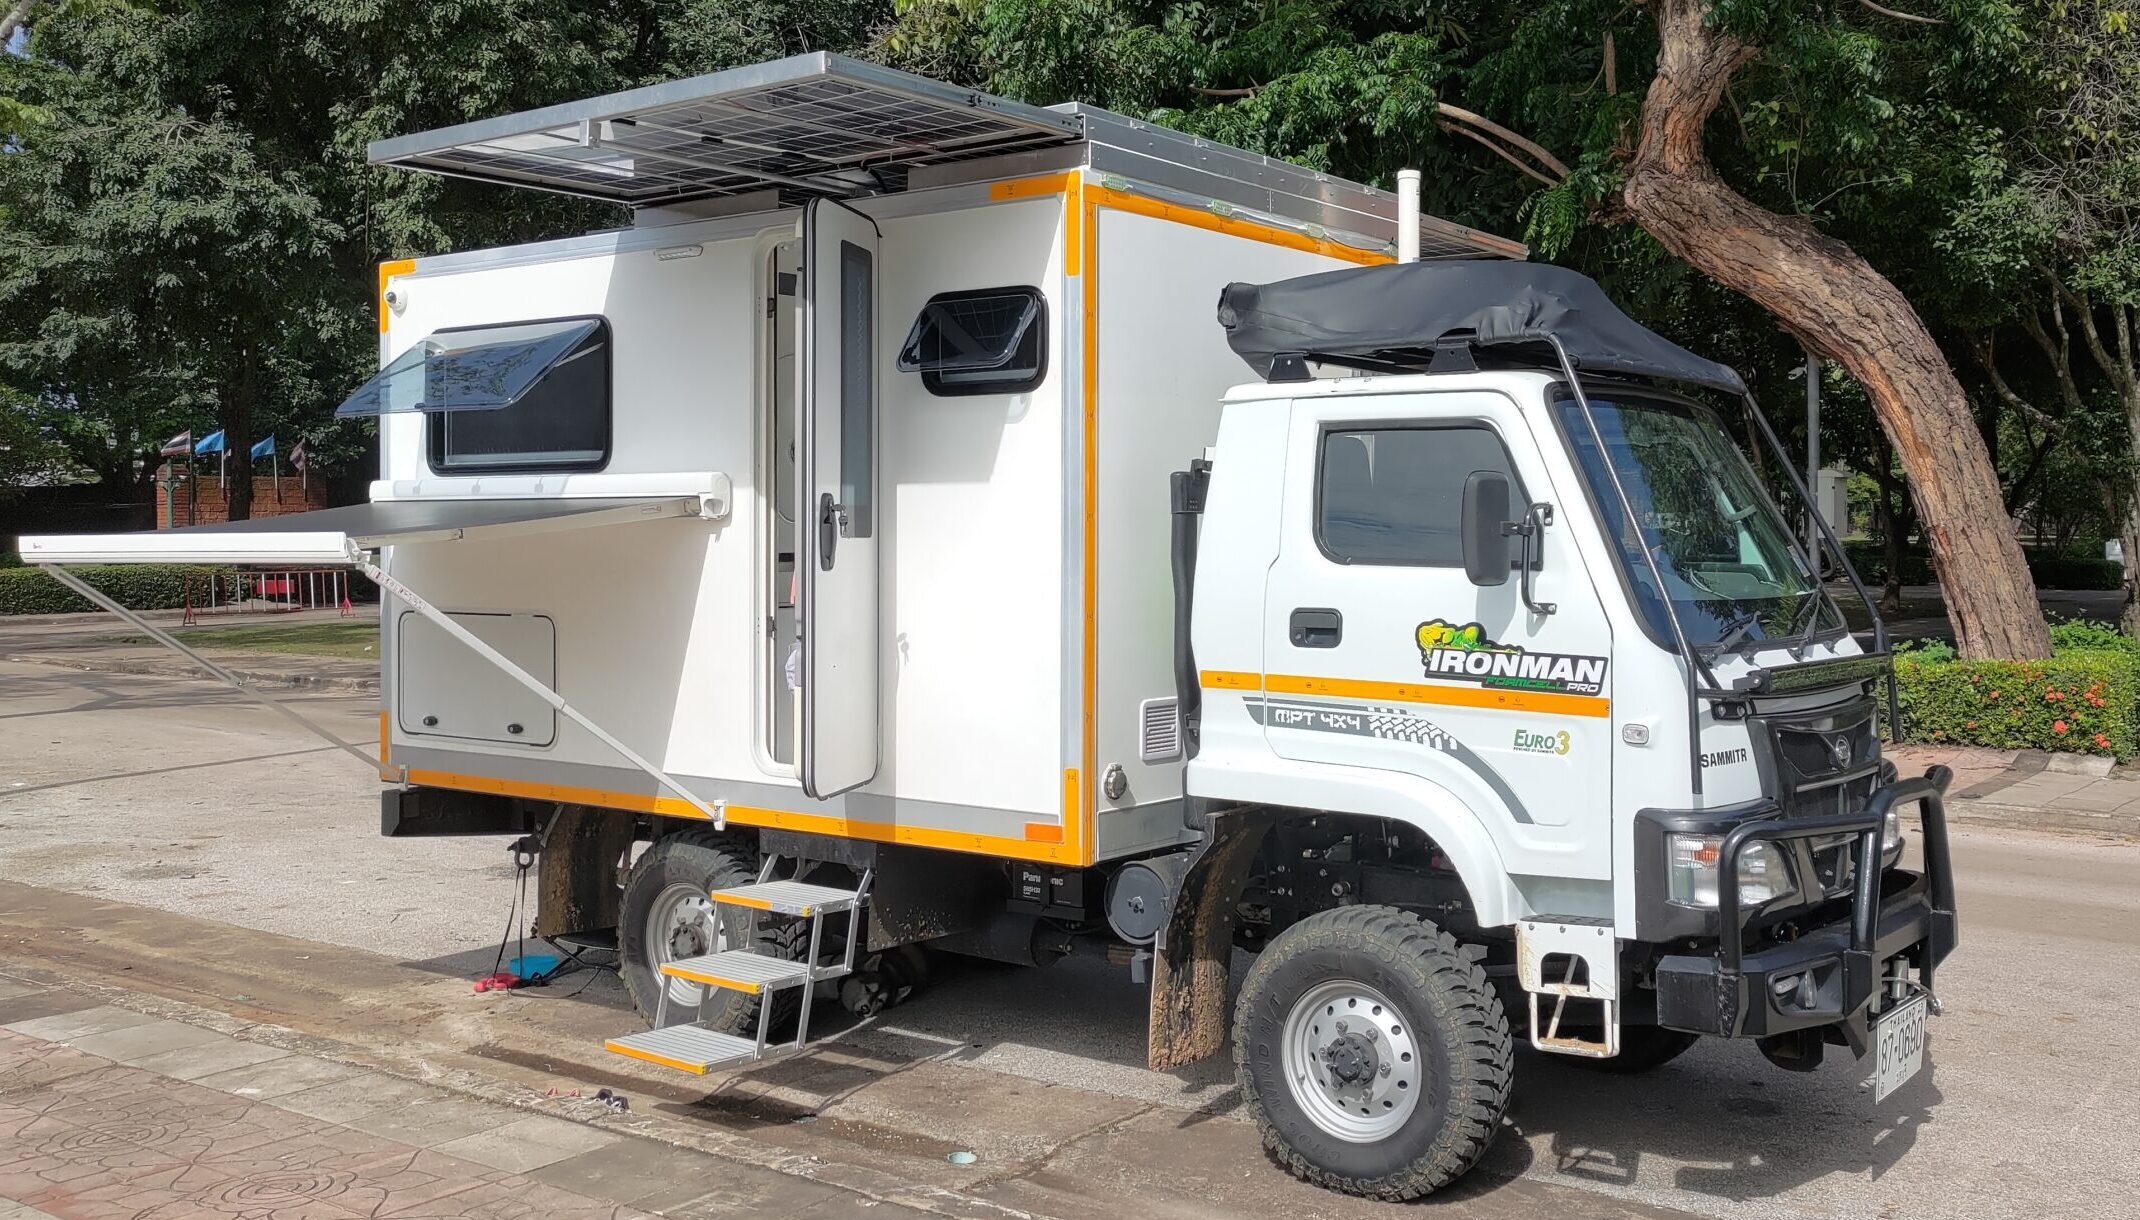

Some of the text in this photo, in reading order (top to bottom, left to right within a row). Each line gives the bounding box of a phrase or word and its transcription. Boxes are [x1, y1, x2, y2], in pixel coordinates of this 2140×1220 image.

[1429, 650, 1604, 683] IRONMAN
[1566, 682, 1599, 693] PRO
[1275, 709, 1316, 726] MPT
[1700, 748, 1747, 768] SAMMITR
[1881, 1016, 1923, 1075] 87-0690
